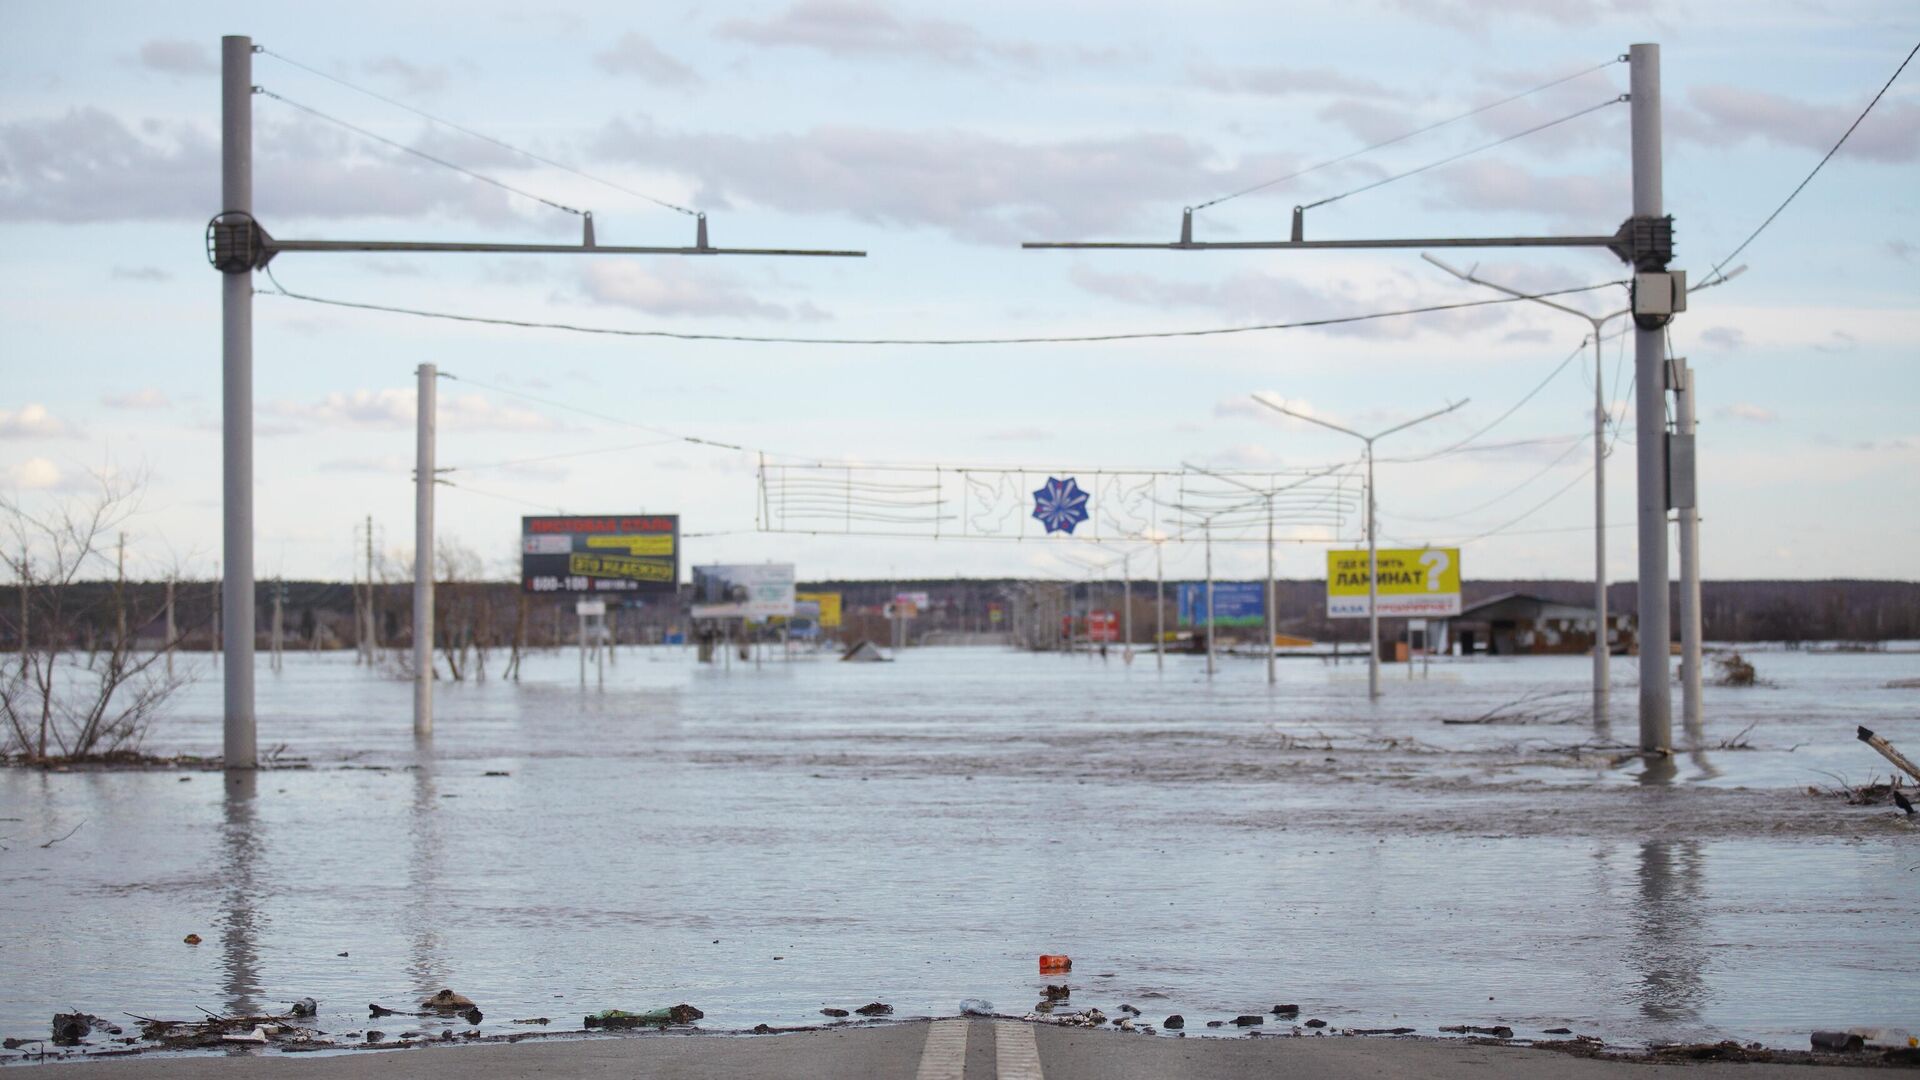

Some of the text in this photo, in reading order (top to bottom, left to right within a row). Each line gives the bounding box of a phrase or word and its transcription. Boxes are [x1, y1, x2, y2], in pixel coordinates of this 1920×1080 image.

[528, 517, 673, 532] ЛИСТОВАЯ СТАЛЬ
[1337, 560, 1357, 569] ГДЕ
